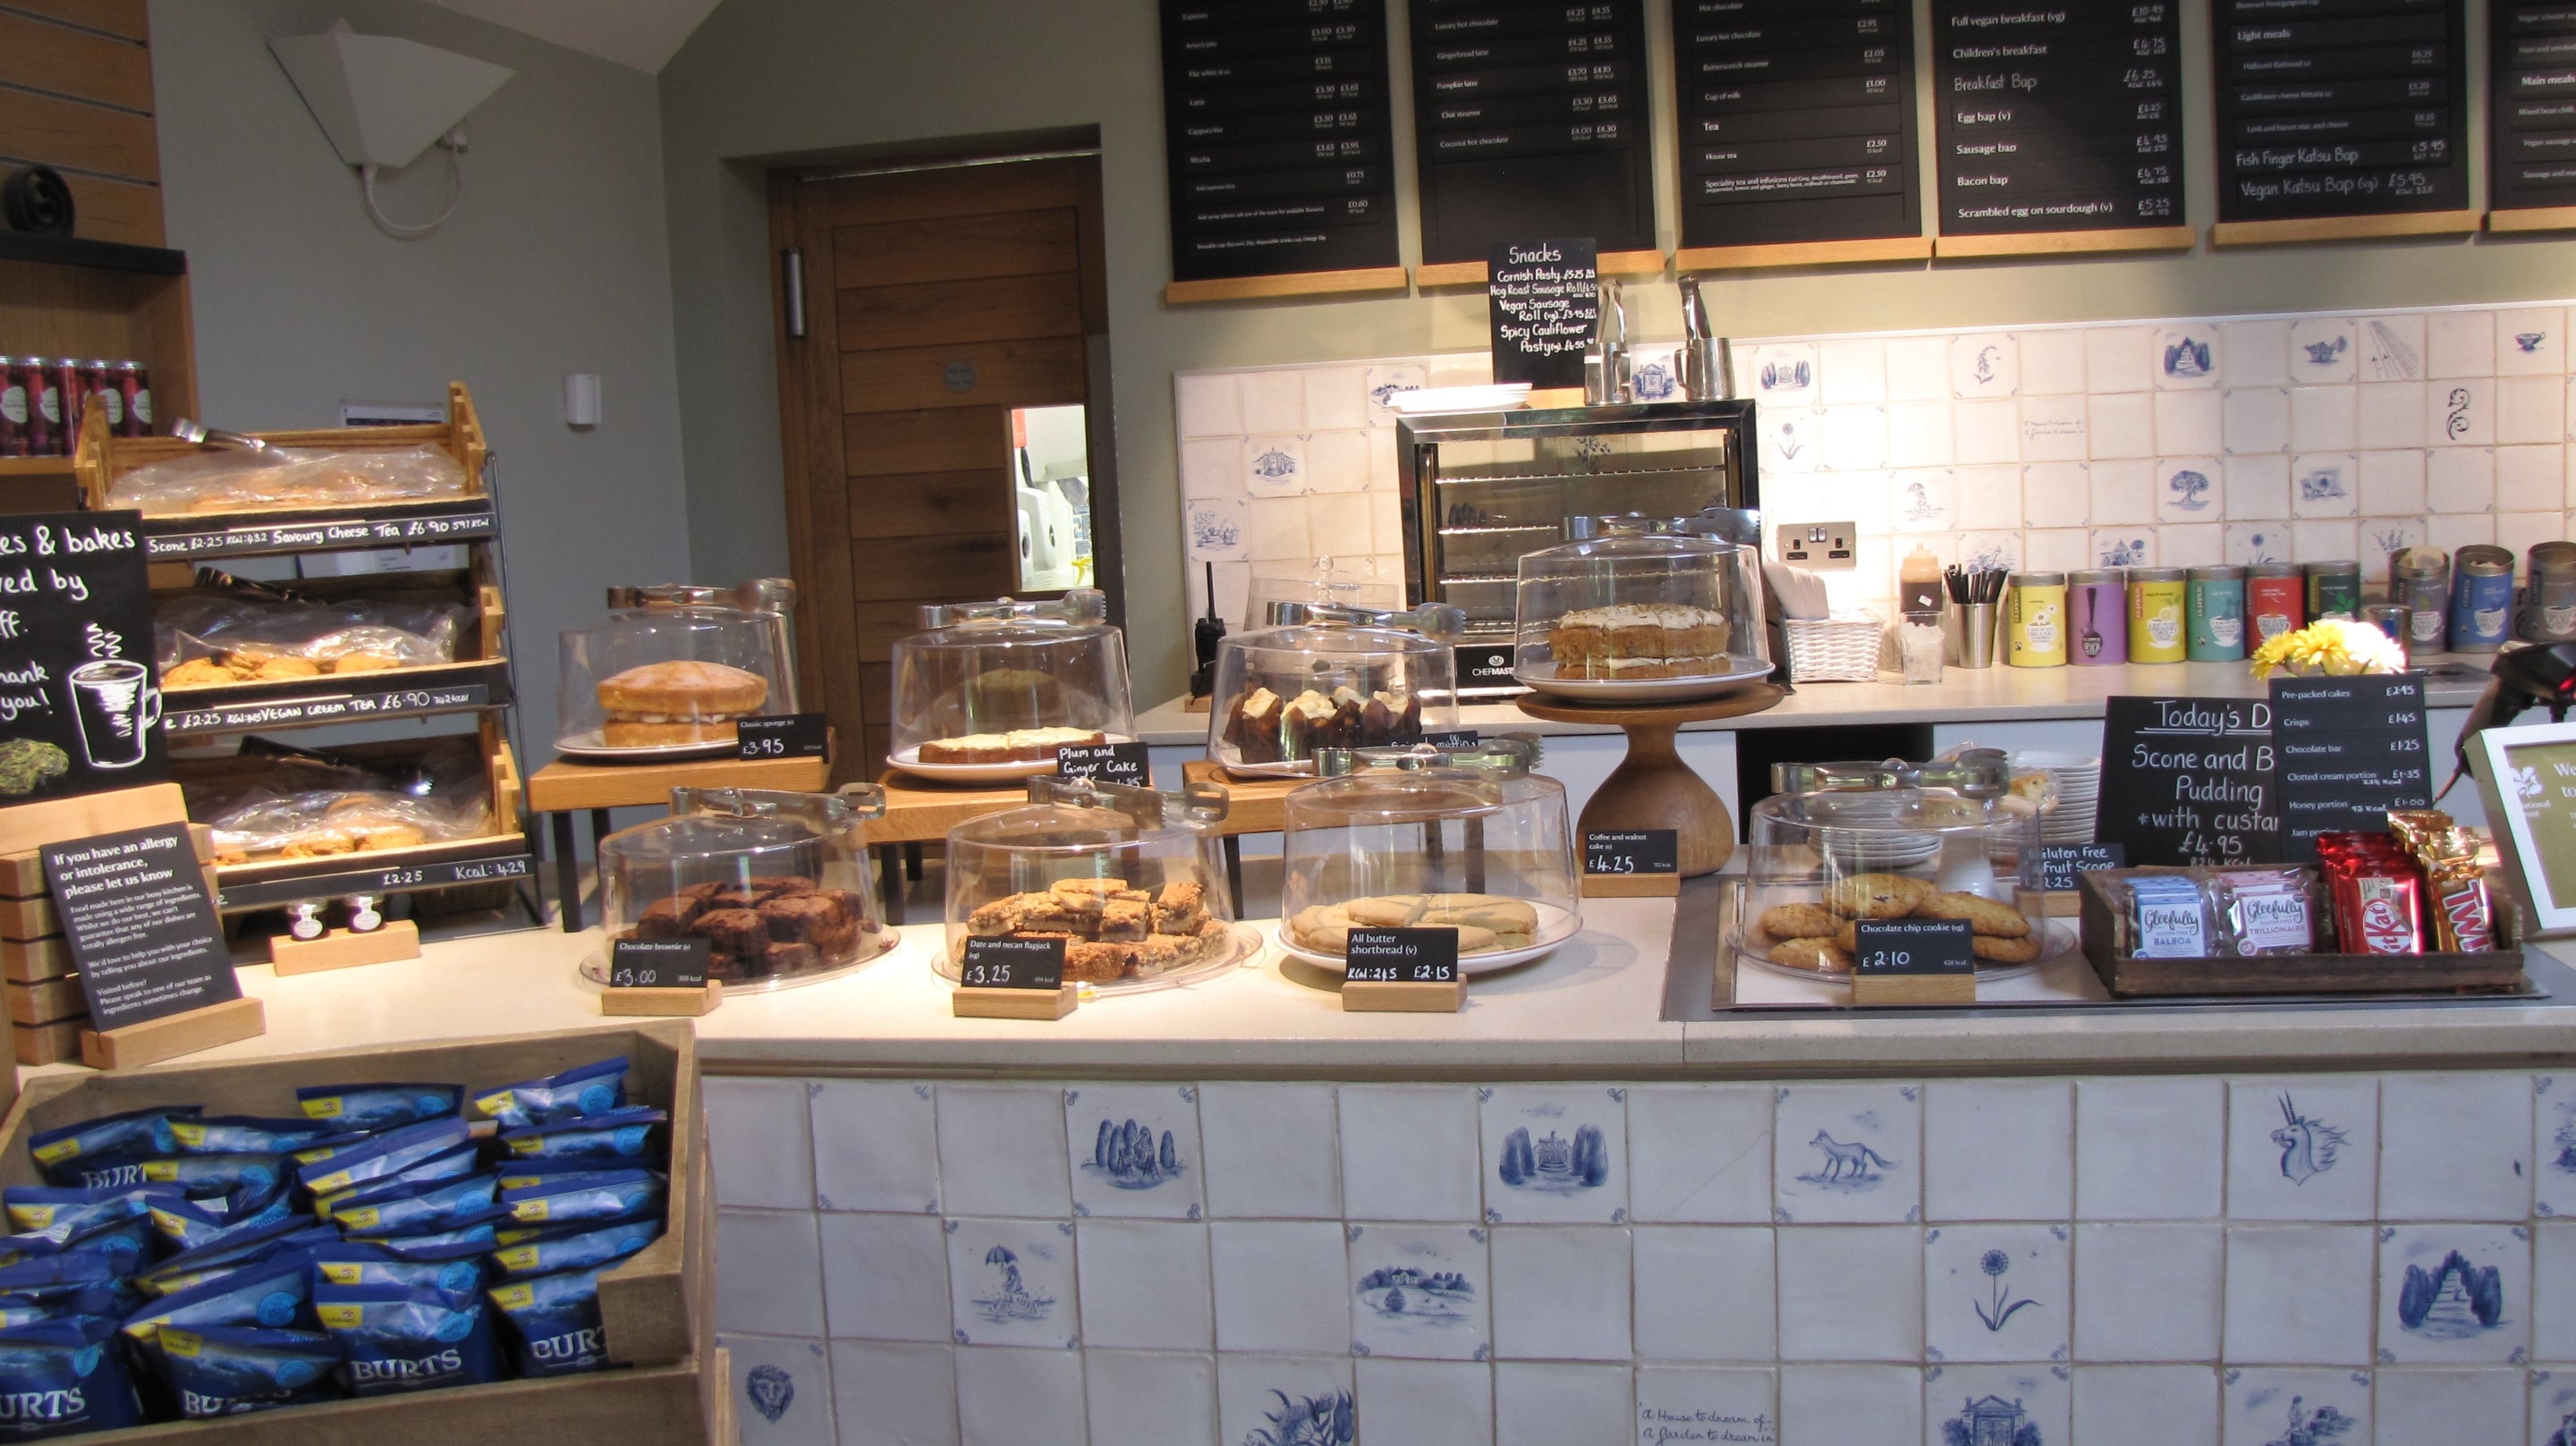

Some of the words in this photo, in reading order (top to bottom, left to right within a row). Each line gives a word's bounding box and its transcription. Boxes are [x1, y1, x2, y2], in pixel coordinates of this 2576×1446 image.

[1952, 17, 1969, 26] Full
[1970, 17, 1998, 28] vegan
[2000, 13, 2046, 24] breakfast
[2237, 30, 2260, 41] Light
[2263, 29, 2290, 39] meals
[1953, 47, 2001, 59] Children's
[2003, 45, 2047, 56] breakfast
[1954, 74, 2005, 91] Breakfast
[2012, 74, 2038, 92] Bap
[2521, 75, 2546, 87] Main
[2547, 73, 2576, 86] meals
[1958, 113, 1976, 124] Egg
[1978, 111, 1996, 123] bap
[1998, 110, 2011, 122] (v)
[1703, 122, 1719, 131] Tea
[1706, 152, 1726, 161] House
[1727, 151, 1737, 159] tea
[1956, 144, 1996, 156] Sausage
[2236, 151, 2259, 167] Fish
[2263, 150, 2295, 169] Finger
[2298, 147, 2332, 164] Katsu
[2334, 146, 2359, 165] Bap
[1706, 179, 1733, 190] Speciality
[1736, 178, 1745, 186] tea
[1747, 176, 1758, 185] and
[1957, 176, 1987, 187] Bacon
[1989, 174, 2008, 187] bap
[2241, 181, 2279, 200] Vegan
[2283, 178, 2321, 195] Katsu
[2324, 176, 2355, 196] Bap
[1958, 206, 2009, 219] Scrambled
[2011, 207, 2029, 217] egg
[2030, 206, 2044, 215] on
[2045, 202, 2098, 216] sourdough
[2099, 202, 2113, 214] (v)
[1509, 242, 1562, 265] Snacks
[1497, 268, 1533, 283] Cornish
[1535, 266, 1560, 284] Pasty
[1490, 285, 1506, 300] Hog
[1507, 283, 1530, 297] Roast
[1532, 283, 1564, 297] Sausage
[1500, 300, 1527, 315] Vegan
[1529, 299, 1570, 312] Sausage
[1519, 309, 1540, 322] Roll
[1501, 325, 1530, 342] Spicy
[1532, 323, 1588, 336] Cauliflower
[1521, 337, 1550, 357] Pasty
[65, 526, 136, 553] bakes
[148, 537, 189, 554] Scone
[272, 528, 325, 546] Savoury
[328, 524, 370, 539] Cheese
[375, 522, 401, 537] Tea
[51, 568, 89, 602] by
[2281, 690, 2326, 701] Pre-packed
[2327, 689, 2351, 698] cakes
[1, 687, 54, 721] you!
[260, 706, 302, 721] VEGAN
[350, 699, 377, 712] TEA
[2152, 700, 2241, 737] Today's
[2283, 717, 2310, 728] Crisps
[1059, 747, 1089, 760] Plum
[1093, 744, 1116, 757] and
[2131, 742, 2199, 770] Scone
[2203, 744, 2246, 771] and
[2284, 744, 2326, 755] Chocolate
[2327, 744, 2343, 753] bar
[1063, 760, 1100, 779] Ginger
[1106, 759, 1139, 773] Cake
[2286, 772, 2318, 782] Clotted
[2318, 772, 2344, 782] cream
[2345, 771, 2377, 782] portion
[2174, 774, 2263, 812] Pudding
[2289, 800, 2317, 811] Honey
[2317, 799, 2349, 810] portion
[1611, 833, 1624, 841] and
[2176, 831, 2242, 856] £4.95
[54, 853, 65, 867] If
[67, 852, 91, 868] you
[92, 846, 121, 861] have
[123, 843, 139, 856] an
[140, 835, 179, 852] allergy
[1589, 842, 1604, 850] cake
[2081, 846, 2109, 858] Free
[59, 869, 74, 883] or
[76, 858, 148, 879] intolerance,
[495, 859, 528, 877] 429
[1589, 854, 1635, 875] £4.25
[2042, 859, 2073, 874] Fruit
[64, 881, 105, 900] please
[106, 875, 123, 891] let
[125, 875, 140, 888] us
[142, 867, 174, 884] know
[2247, 899, 2303, 924] Gleefully
[1860, 924, 1902, 933] Chocolate
[1903, 923, 1921, 934] chip
[1922, 923, 1950, 932] cookie
[2144, 909, 2199, 936] Gleefully
[2250, 924, 2306, 935] TRILLIONAIRE
[619, 942, 653, 951] Chocolate
[970, 940, 987, 949] Date
[987, 940, 1002, 949] and
[1024, 941, 1052, 951] flapjack
[1351, 934, 1364, 943] All
[1366, 934, 1396, 944] butter
[2153, 936, 2191, 945] BALBOA
[1351, 944, 1403, 955] shortbread
[1405, 945, 1418, 956] (v)
[616, 968, 657, 987] £3.00
[966, 964, 1012, 985] £3.25
[1413, 964, 1450, 980] £2.15
[350, 1347, 462, 1381] BURTS
[1657, 1408, 1694, 1423] House
[1696, 1408, 1708, 1422] to
[1707, 1410, 1749, 1424] dream
[1707, 1428, 1718, 1441] to
[1720, 1429, 1758, 1442] dream
